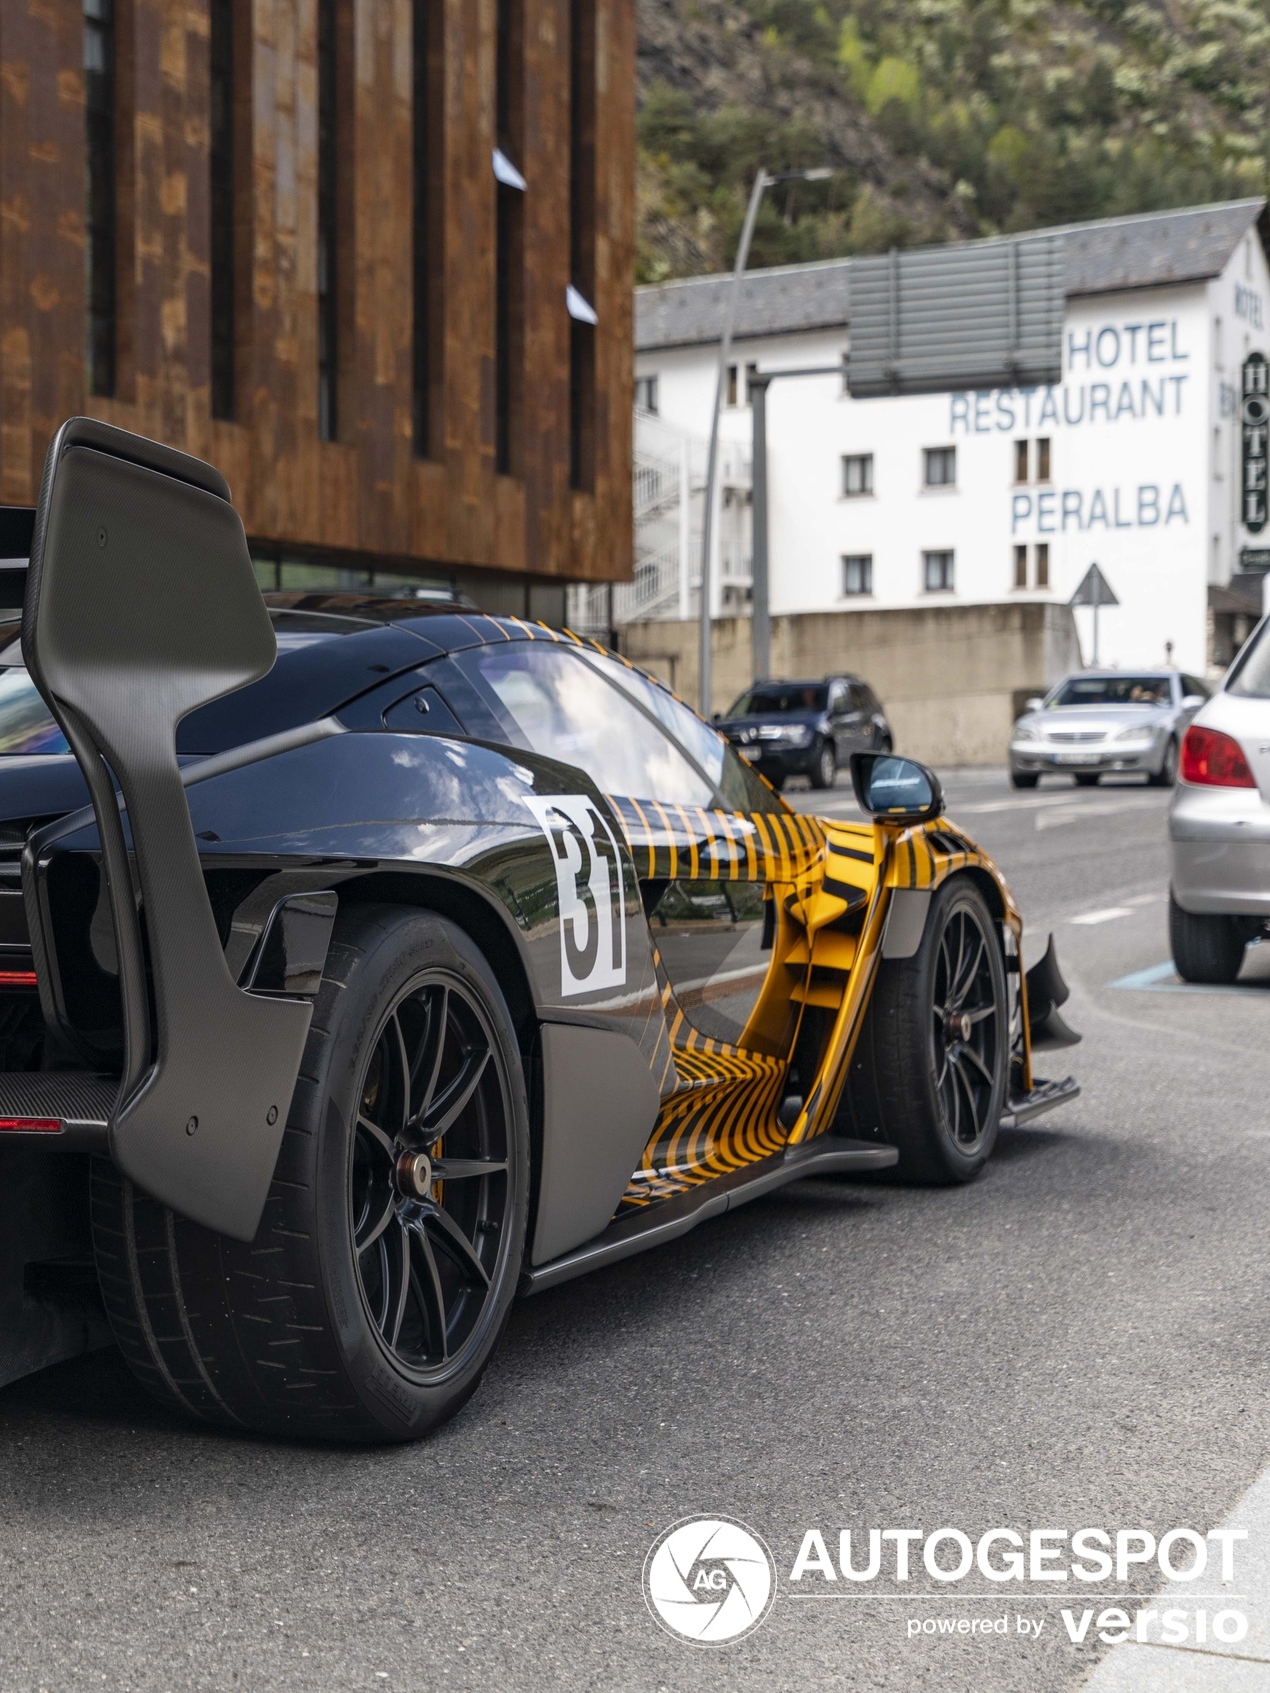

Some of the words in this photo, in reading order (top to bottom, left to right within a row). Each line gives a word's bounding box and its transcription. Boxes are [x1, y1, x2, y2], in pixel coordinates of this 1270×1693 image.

[1067, 319, 1190, 369] HOTEL
[949, 375, 1189, 434] RESTAURANT
[1242, 361, 1268, 523] HOTEL
[1011, 483, 1190, 534] PERALBA
[545, 806, 623, 981] 31
